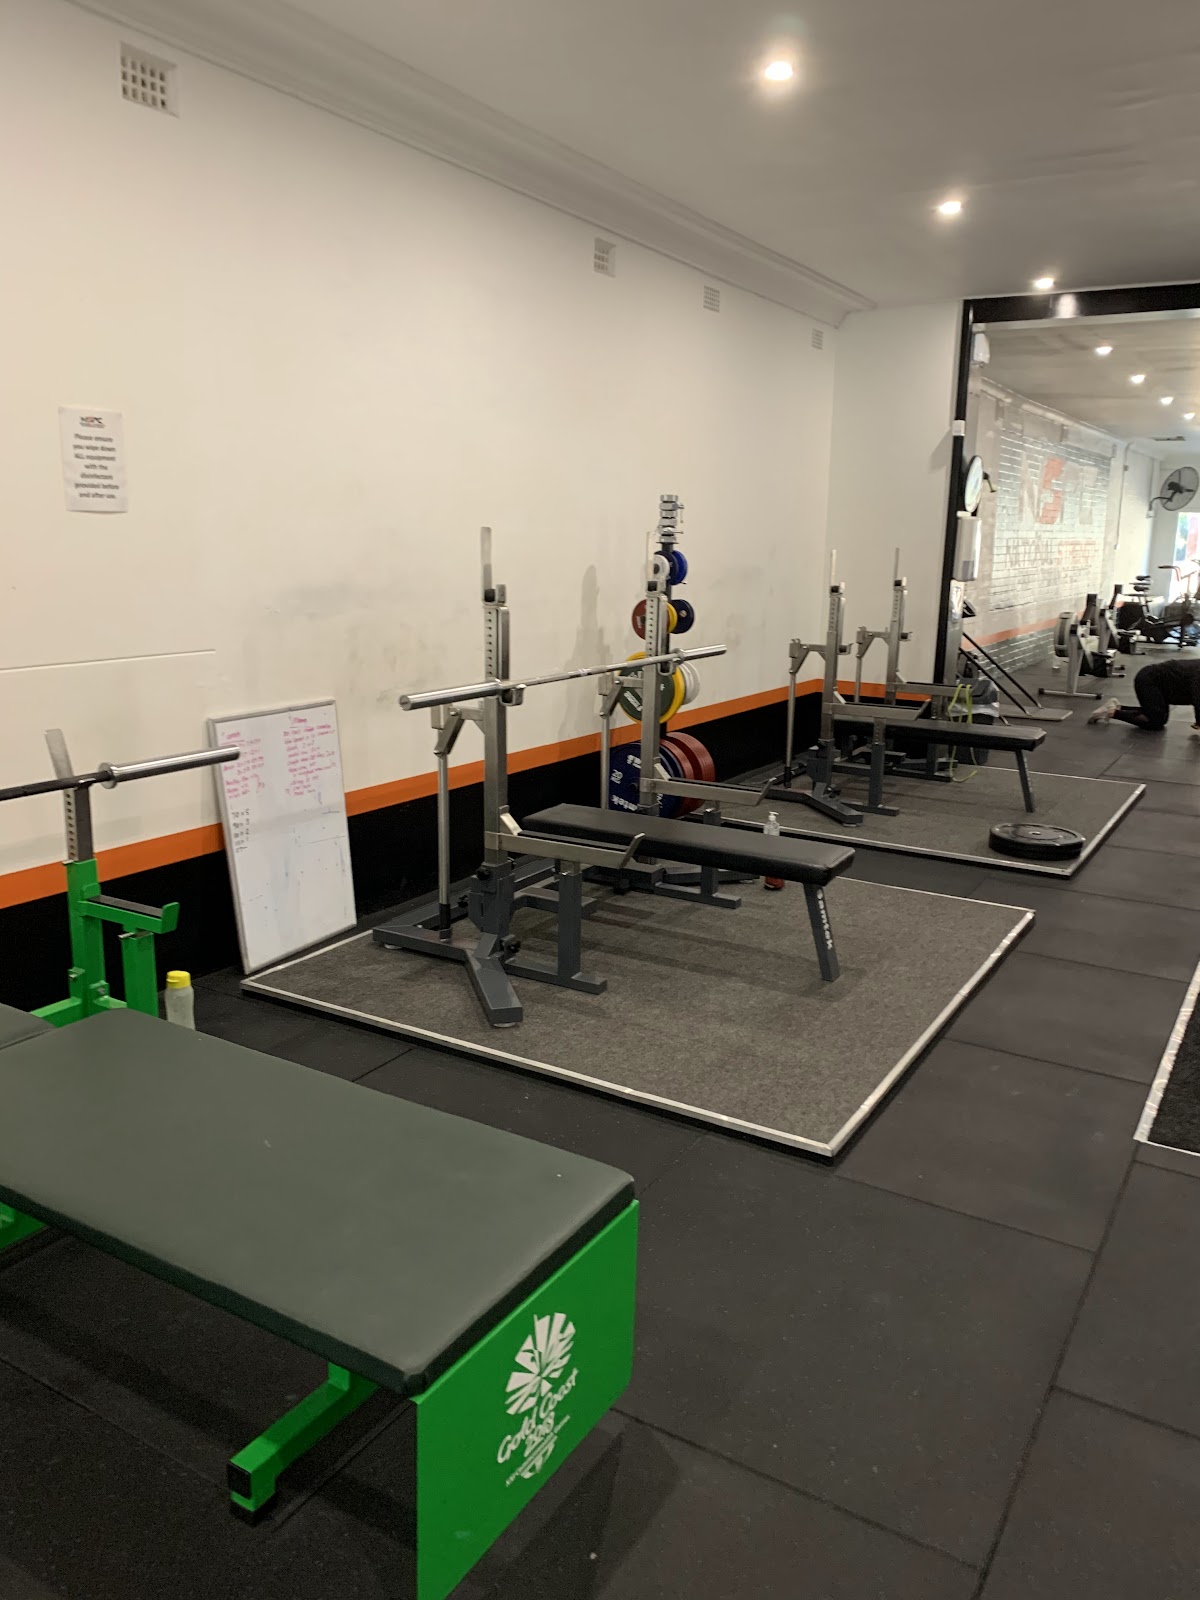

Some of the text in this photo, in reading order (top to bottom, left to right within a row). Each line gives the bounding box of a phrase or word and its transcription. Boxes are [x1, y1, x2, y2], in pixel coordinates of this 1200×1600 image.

[497, 1406, 538, 1464] Gold
[539, 1368, 578, 1419] Coast
[524, 1411, 556, 1458] 2018
